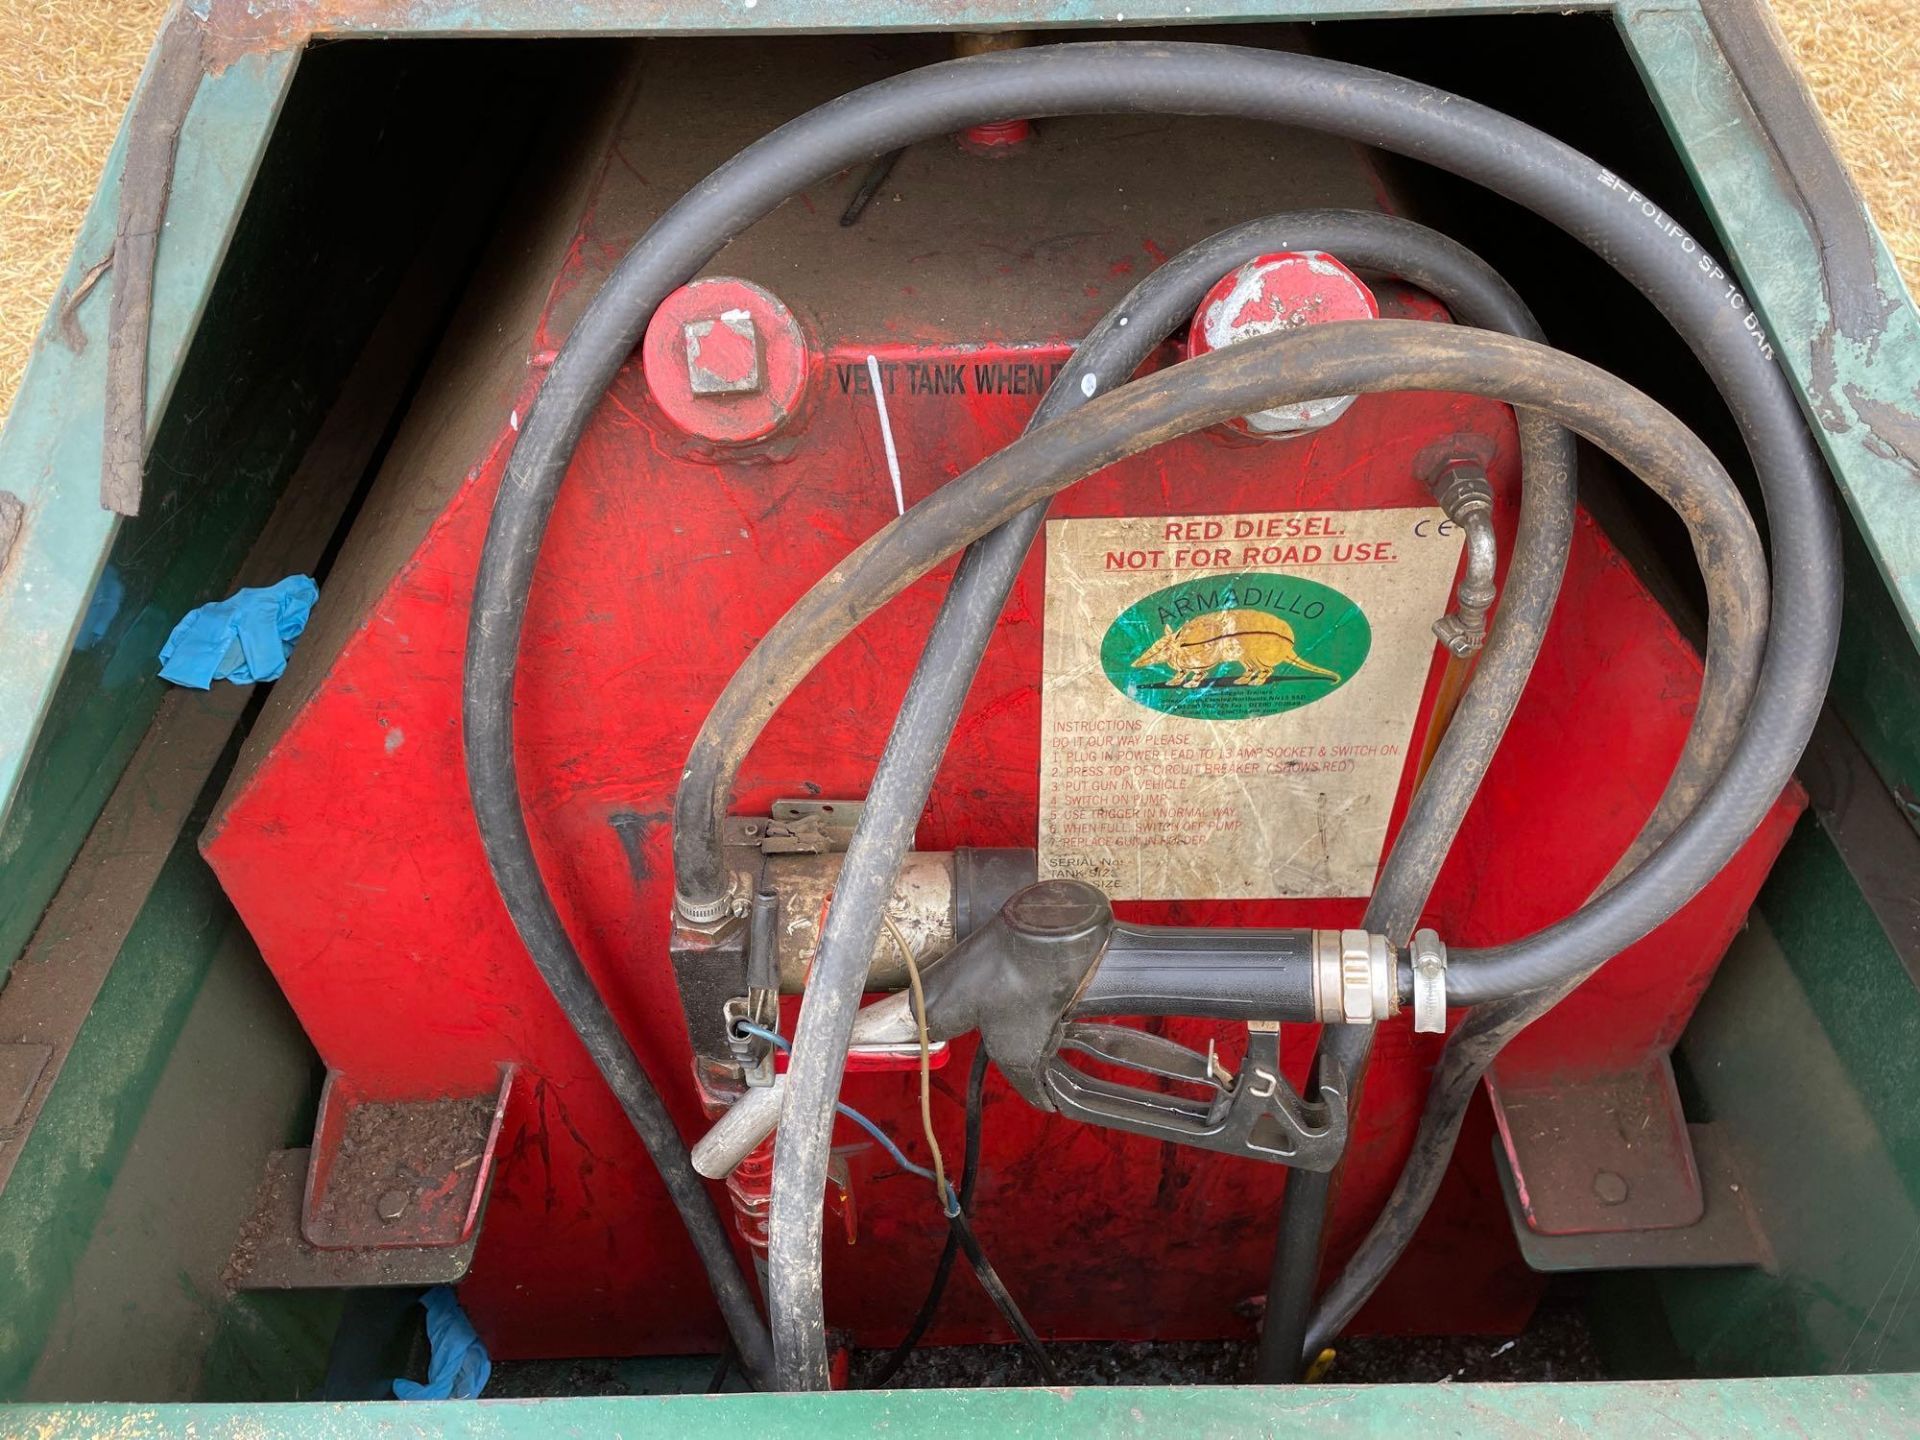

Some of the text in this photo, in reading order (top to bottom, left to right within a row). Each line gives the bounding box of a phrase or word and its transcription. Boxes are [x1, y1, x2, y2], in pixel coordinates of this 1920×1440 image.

[1628, 190, 1696, 254] POLIPO
[1698, 255, 1725, 281] SP
[1743, 311, 1775, 361] BAR
[906, 363, 967, 395] TANK
[974, 363, 1043, 396] WHEN
[1164, 517, 1346, 541] RED DIESEL.
[1105, 541, 1398, 570] NOT FOR ROAD USE.
[1156, 586, 1325, 626] ARMADILLO
[1053, 719, 1143, 732] INSTRUCTIONS
[1052, 734, 1190, 748] DO IT OUR WAY PLEASE
[1067, 751, 1097, 762] PLUG
[1101, 750, 1113, 761] IN
[1117, 749, 1160, 761] POWER
[1164, 748, 1194, 760] LEAD
[1200, 748, 1213, 759] TO
[1237, 747, 1262, 759] AMP
[1267, 746, 1315, 758] SOCKET
[1318, 745, 1326, 757] &
[1331, 744, 1377, 757] SWITCH
[1066, 766, 1104, 777] PRESS
[1108, 765, 1130, 776] TOP
[1134, 765, 1148, 776] OF
[1153, 763, 1201, 776] CIRCUIT
[1205, 763, 1260, 775] BREAKER
[1065, 781, 1088, 792] PUT
[1092, 780, 1117, 791] GUN
[1121, 779, 1133, 790] IN
[1138, 778, 1187, 790] VEHICLE
[1065, 795, 1108, 806] SWITCH
[1112, 795, 1129, 805] ON
[1064, 809, 1086, 820] USE
[1091, 808, 1140, 819] TRIGGER
[1144, 808, 1156, 818] IN
[1160, 807, 1207, 818] NORMAL
[1063, 823, 1097, 834] WHEN
[1136, 822, 1179, 832] SWITCH
[1183, 821, 1205, 832] OFF
[1063, 837, 1112, 848] REPLACE
[1050, 857, 1097, 868] SERIAL
[1051, 869, 1084, 878] TANK
[1092, 880, 1122, 888] SIZE
